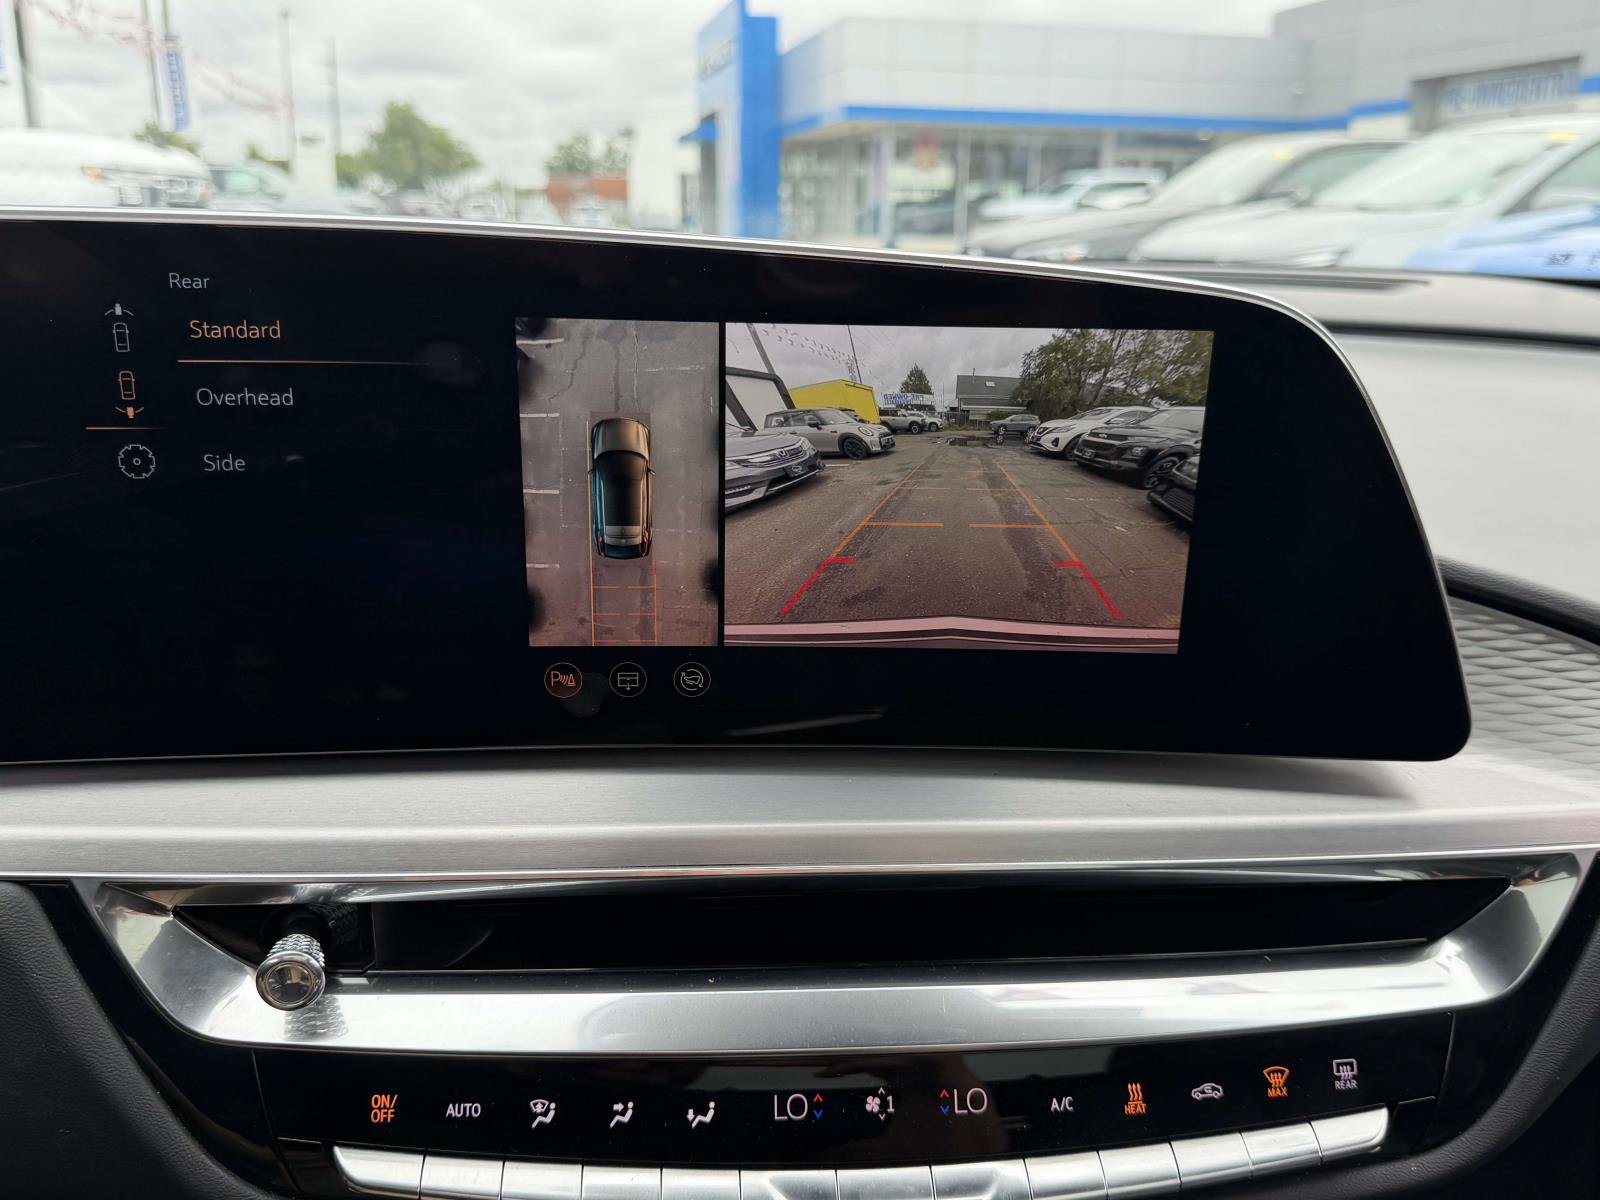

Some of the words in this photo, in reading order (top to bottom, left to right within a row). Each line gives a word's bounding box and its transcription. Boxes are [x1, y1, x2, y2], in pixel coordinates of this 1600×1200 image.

[168, 272, 210, 289] Rear
[189, 319, 281, 339] Standard
[196, 387, 294, 406] Overhead
[203, 453, 246, 472] Side
[1267, 1086, 1288, 1098] MAX
[1334, 1078, 1358, 1090] REAR
[773, 1093, 809, 1121] LO
[886, 1095, 895, 1113] 1
[953, 1087, 988, 1114] LO
[1050, 1096, 1074, 1112] A/C
[1124, 1103, 1147, 1115] HEAT
[371, 1109, 395, 1123] OFF
[445, 1102, 482, 1118] AUTO
